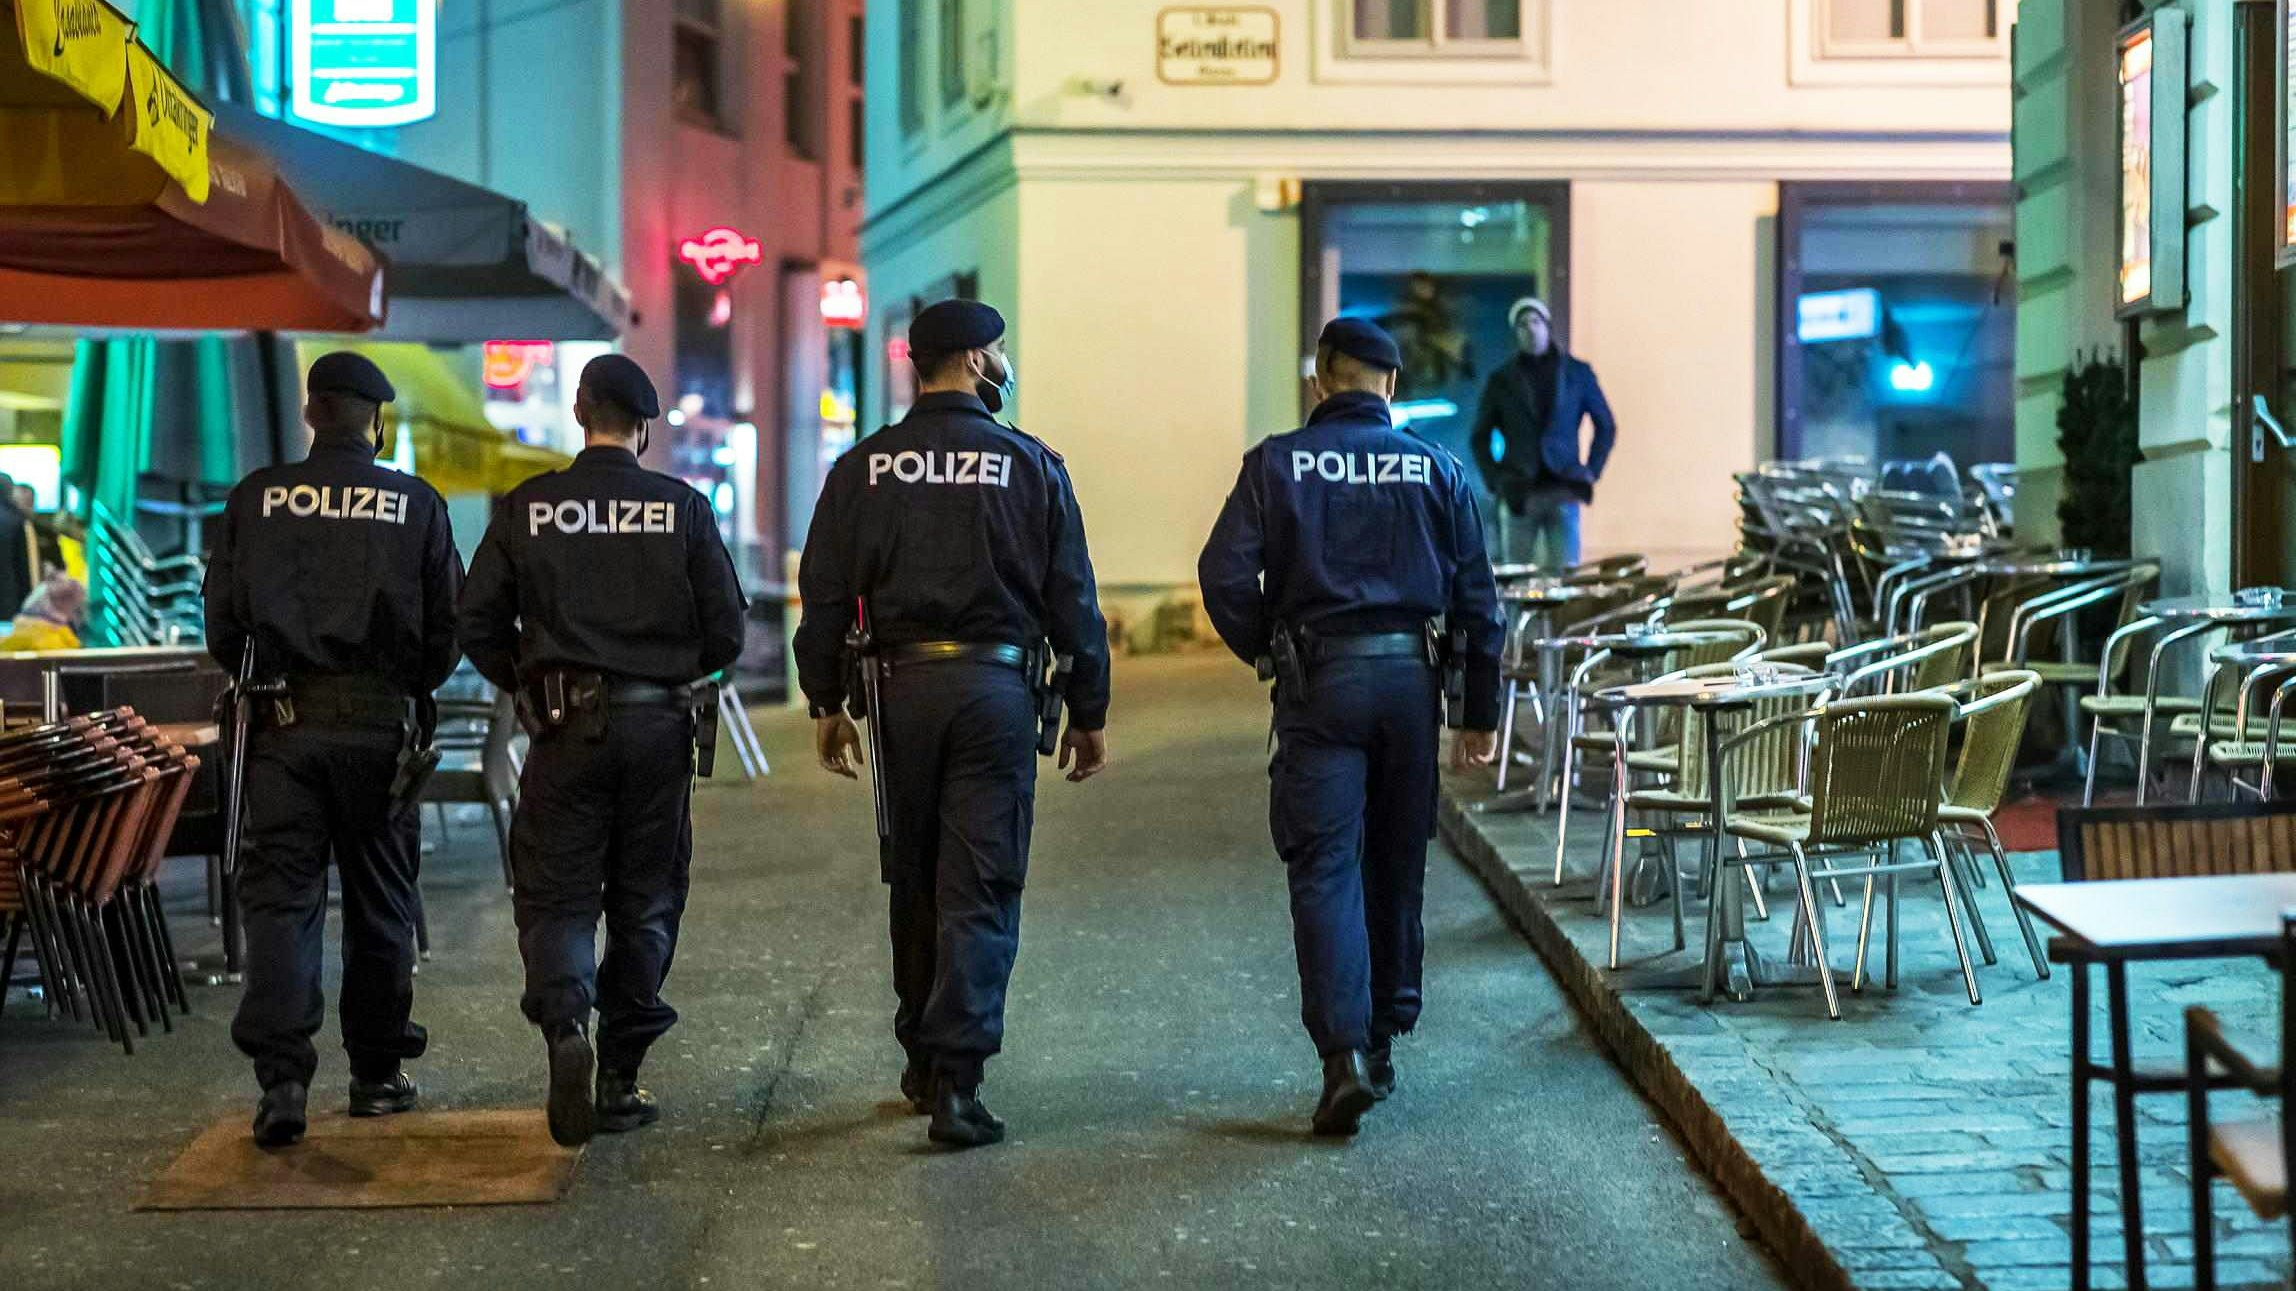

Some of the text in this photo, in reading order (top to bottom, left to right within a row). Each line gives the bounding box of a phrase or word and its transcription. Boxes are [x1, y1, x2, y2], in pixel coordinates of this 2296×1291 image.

[868, 450, 1012, 488] POLIZEI
[1291, 450, 1432, 486] POLIZEI
[262, 484, 409, 526] POLIZEI
[528, 499, 675, 537] POLIZEI
